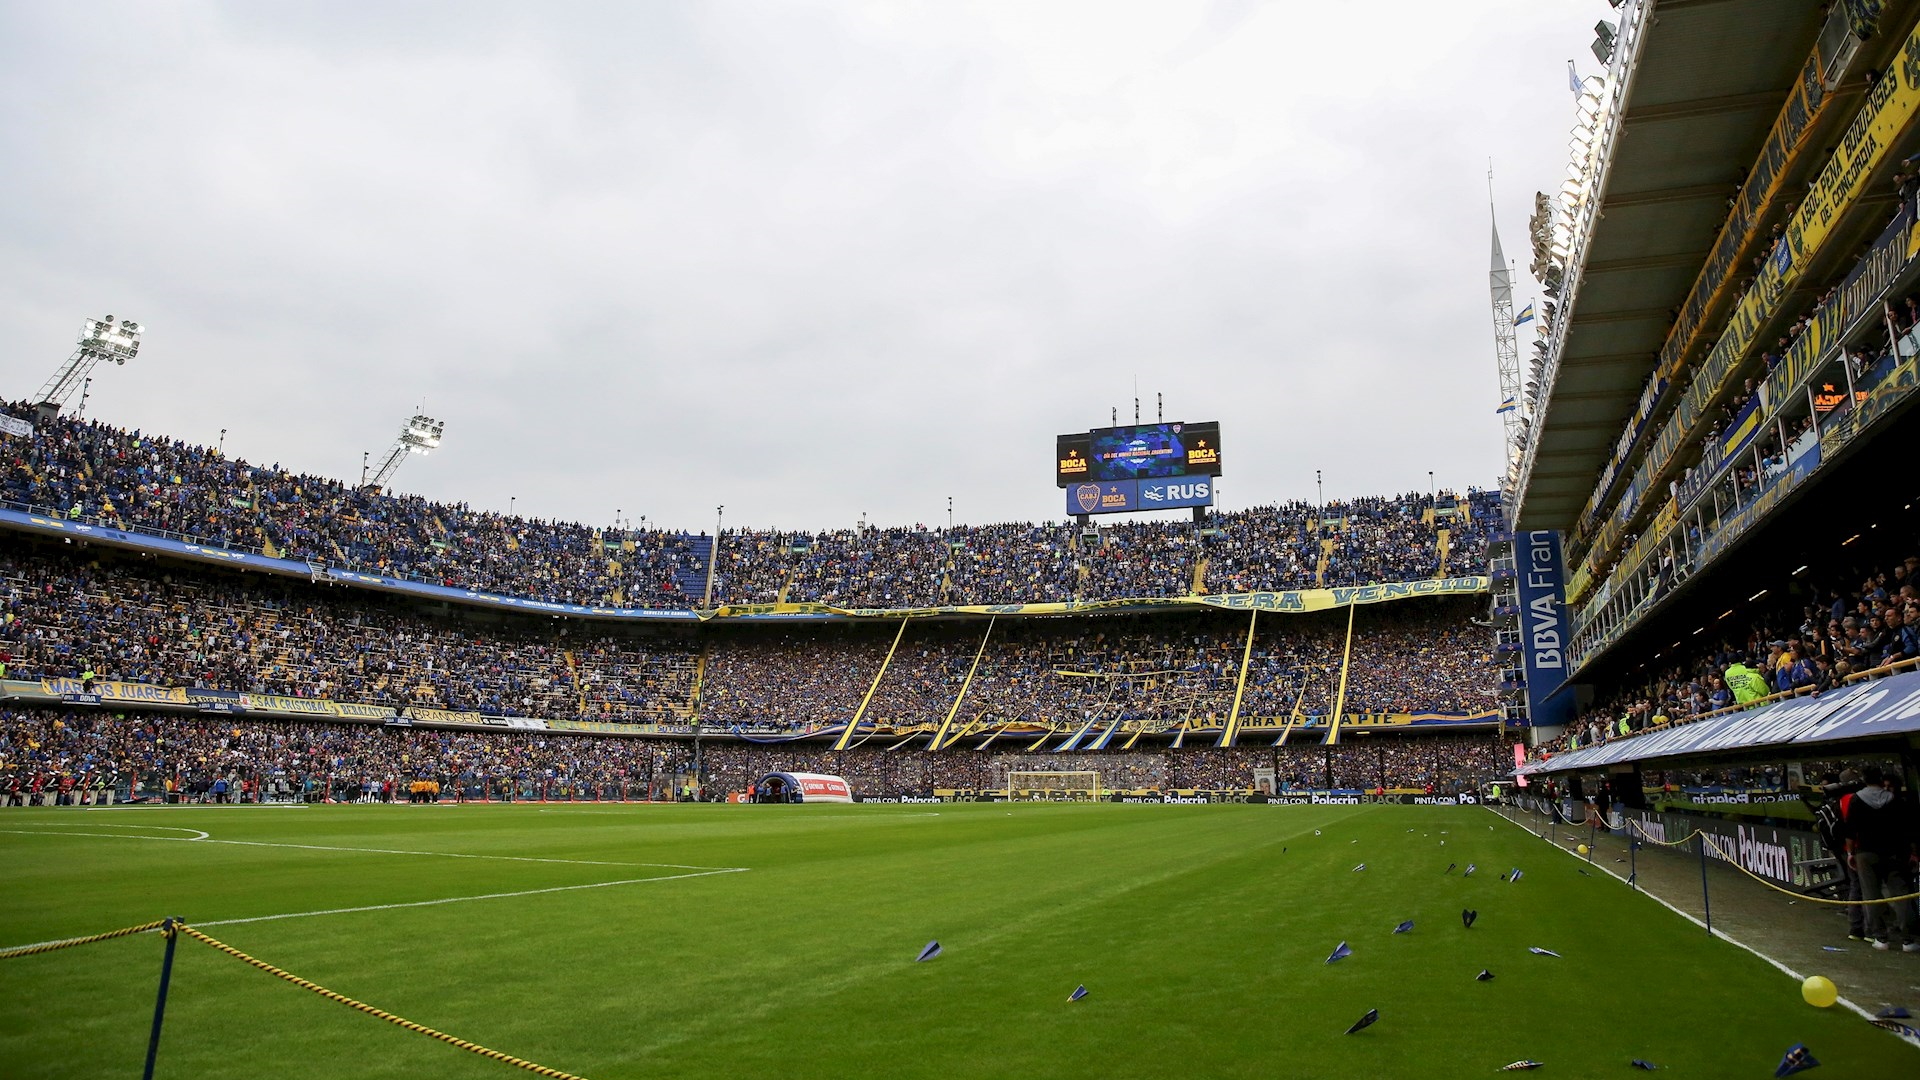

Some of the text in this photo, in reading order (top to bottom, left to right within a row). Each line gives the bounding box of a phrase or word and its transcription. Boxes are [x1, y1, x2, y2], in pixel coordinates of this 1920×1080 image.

[1844, 64, 1898, 161] BOQUENSES
[1832, 133, 1877, 207] CONCORDIA
[1188, 449, 1216, 459] BOCA
[1061, 458, 1087, 468] BOCA
[1102, 494, 1126, 503] BOCA
[1167, 483, 1210, 501] RUS
[1332, 576, 1489, 604] VENCID
[1530, 593, 1562, 669] BBVA
[50, 681, 173, 701] MAROS JUAREZ
[257, 697, 329, 712] SAN CRISTOBAL
[413, 707, 480, 723] BRANDSEN
[1123, 795, 1142, 804] PINTÁ
[1164, 795, 1207, 804] Polacrin
[1210, 796, 1248, 804] BLACK
[1267, 795, 1289, 804] PINTÁ
[1311, 795, 1358, 805] Polacrin
[1361, 795, 1402, 804] BLACK
[1414, 795, 1437, 804] PINTÁ
[1720, 832, 1737, 864] CON
[1738, 825, 1789, 883] Polacrin
